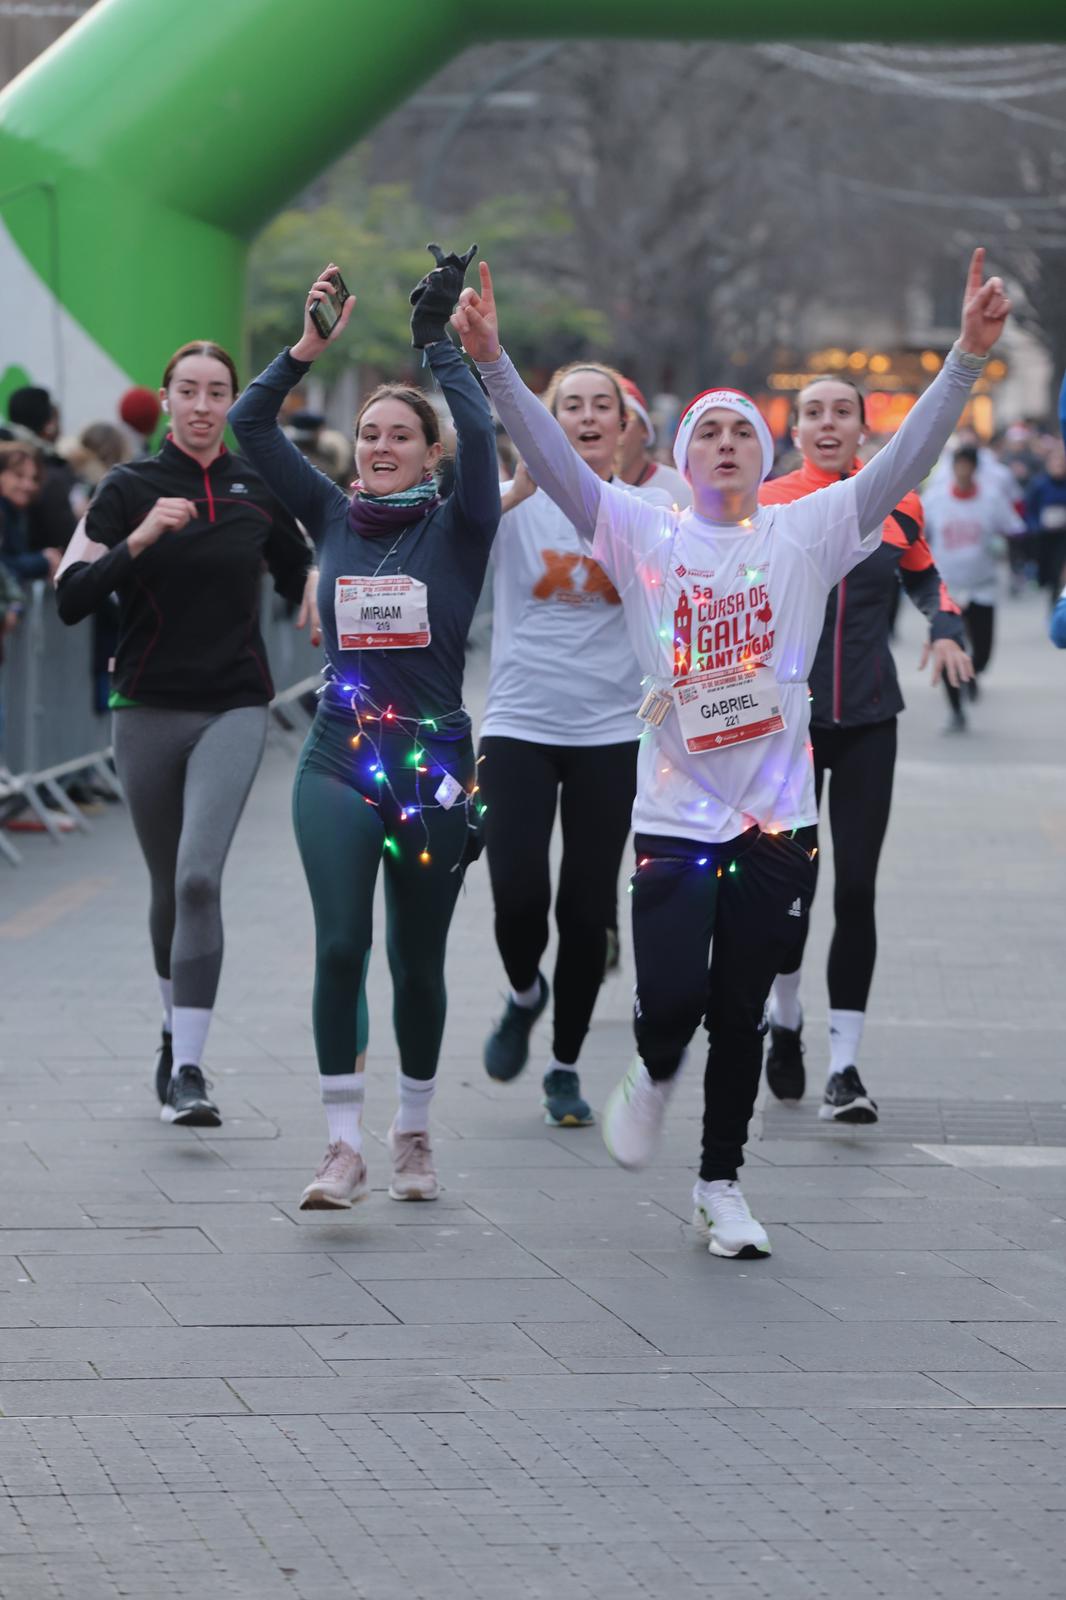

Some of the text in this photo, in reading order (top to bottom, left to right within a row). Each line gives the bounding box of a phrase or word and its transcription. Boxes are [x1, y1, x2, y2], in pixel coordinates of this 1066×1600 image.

[361, 606, 402, 620] MIRIAM
[698, 592, 745, 622] CURSA
[376, 622, 391, 631] 219
[697, 613, 755, 654] GALL
[697, 650, 733, 672] SANT
[701, 694, 759, 719] GABRIEL
[724, 715, 739, 727] 221
